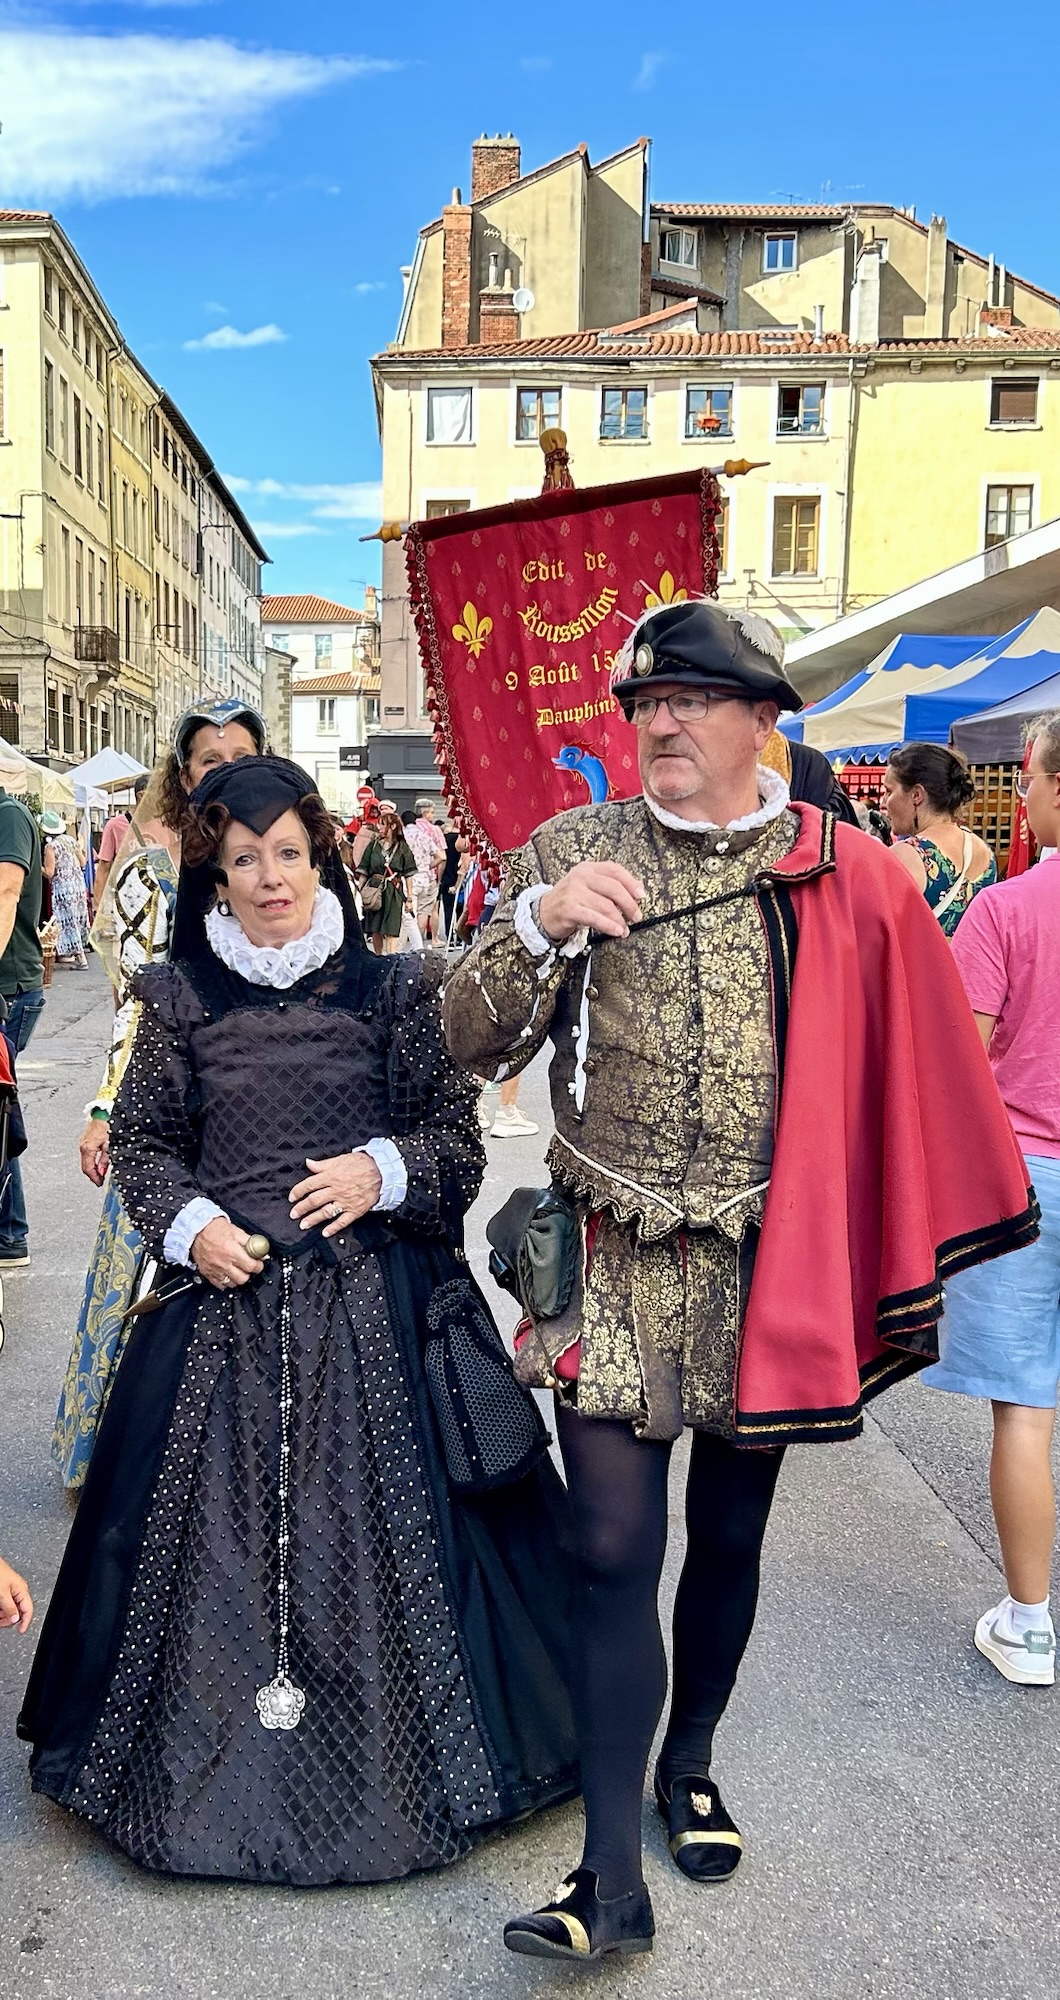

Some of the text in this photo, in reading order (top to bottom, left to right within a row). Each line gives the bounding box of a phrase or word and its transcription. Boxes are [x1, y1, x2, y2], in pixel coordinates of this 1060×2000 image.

[522, 551, 608, 583] Edit de
[517, 586, 619, 644] Roussillon
[505, 671, 519, 691] 9
[528, 661, 579, 687] Août
[1030, 1634, 1049, 1644] NIKE
